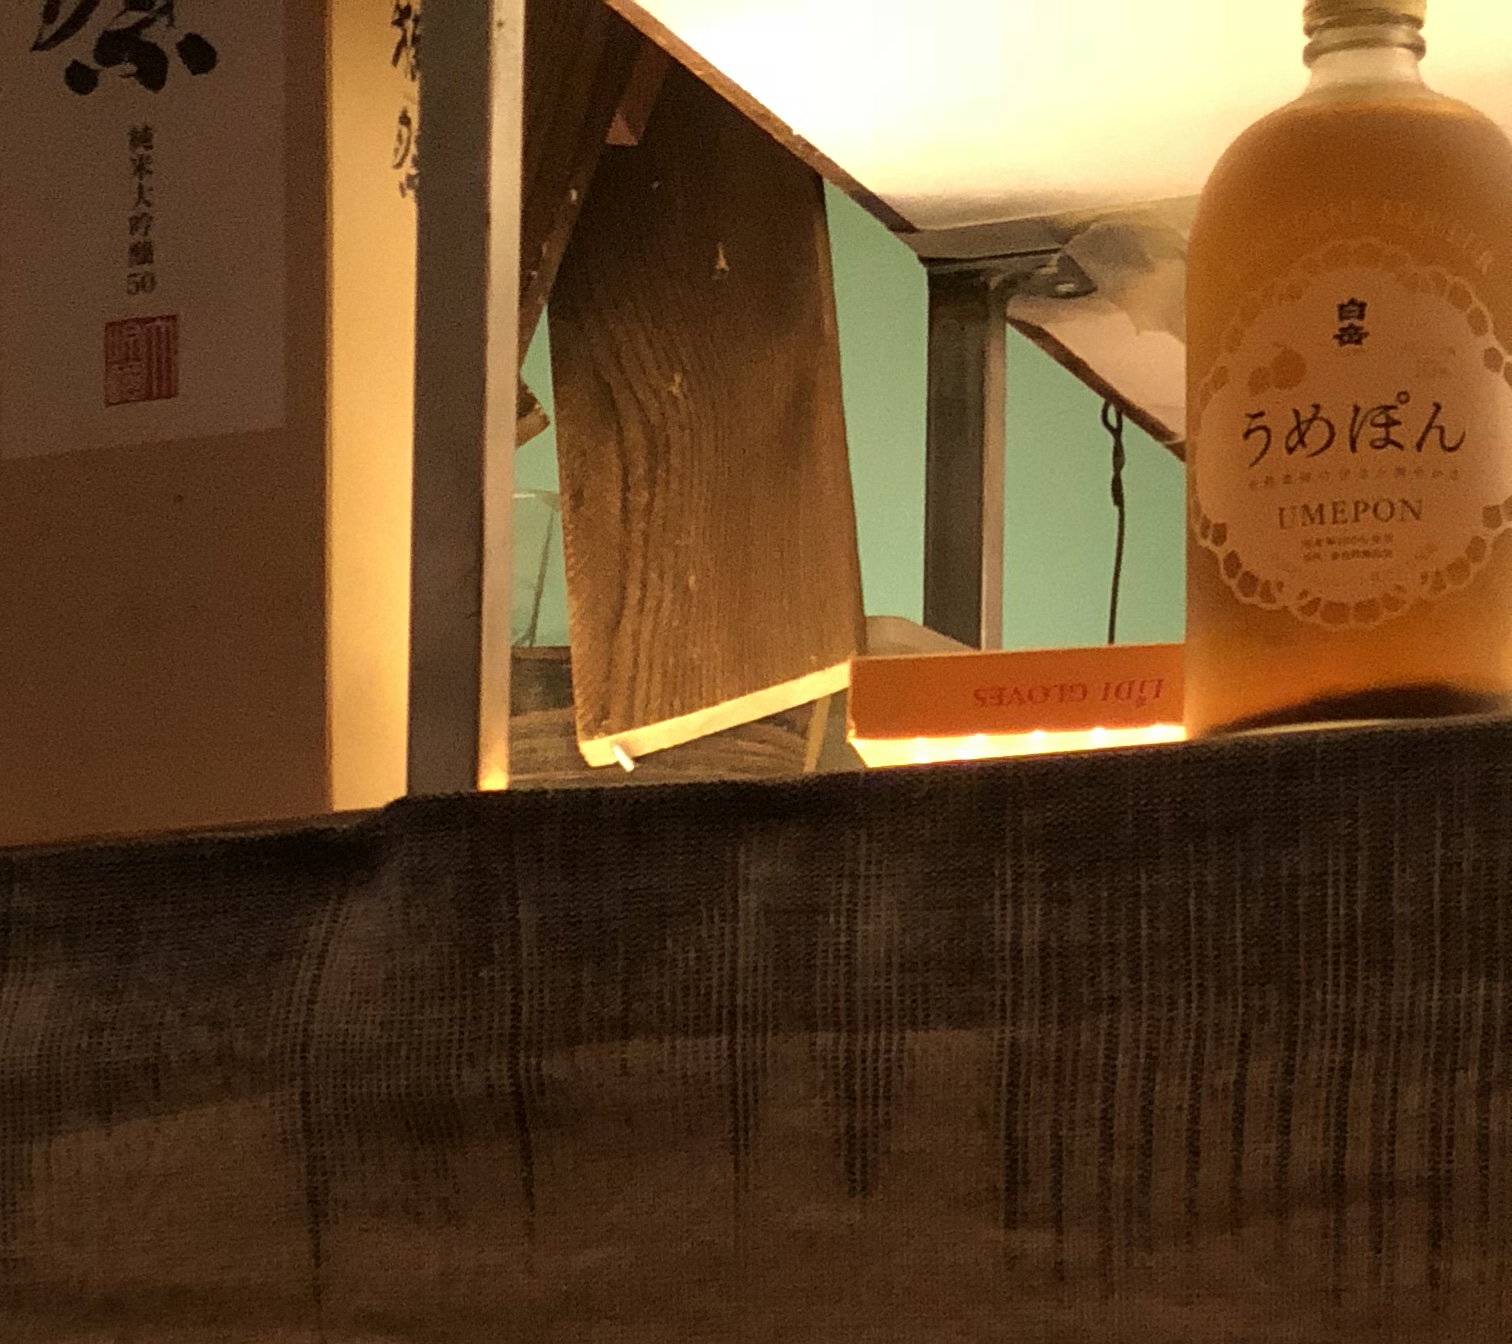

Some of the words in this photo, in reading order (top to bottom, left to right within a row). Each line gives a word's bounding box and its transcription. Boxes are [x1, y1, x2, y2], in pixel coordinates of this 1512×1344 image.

[1240, 389, 1467, 469] うめぽん
[1277, 498, 1424, 531] UMEPON
